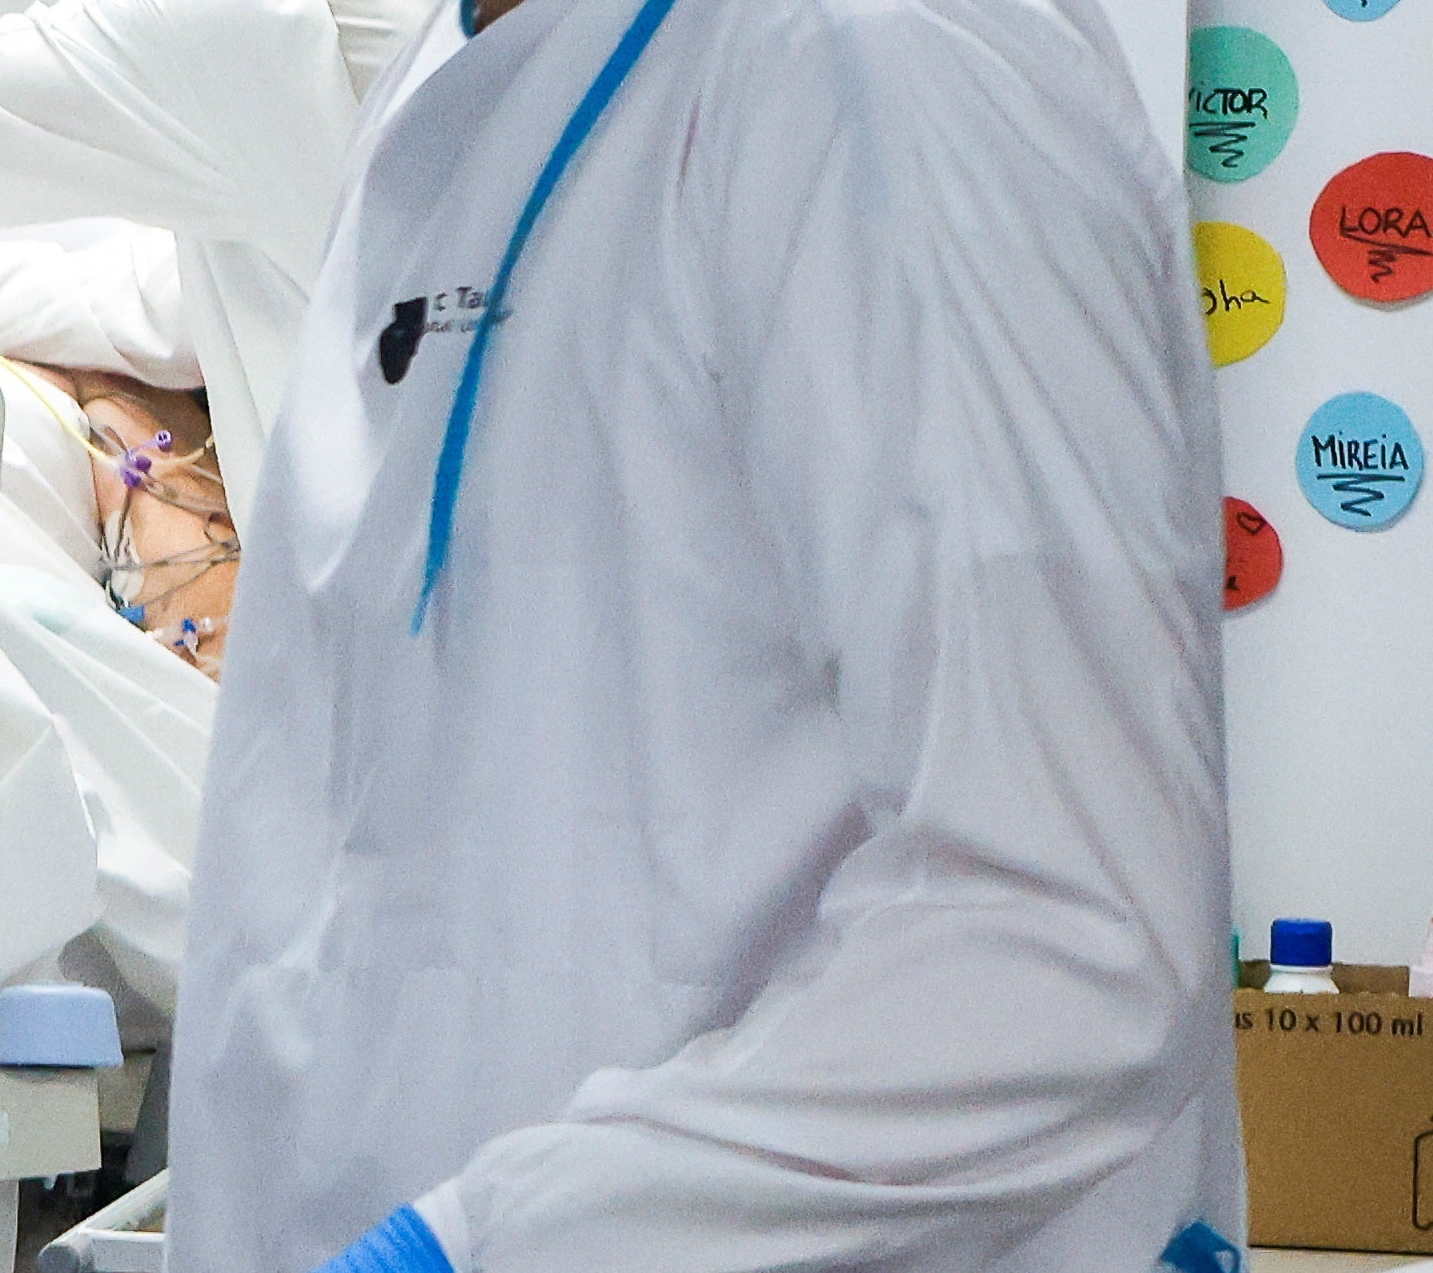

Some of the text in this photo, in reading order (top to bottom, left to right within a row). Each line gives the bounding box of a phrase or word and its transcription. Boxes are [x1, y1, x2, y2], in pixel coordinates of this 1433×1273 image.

[1266, 1008, 1297, 1031] 10
[1305, 1014, 1319, 1032] x
[1335, 1011, 1382, 1034] 100
[1391, 1012, 1423, 1036] ml
